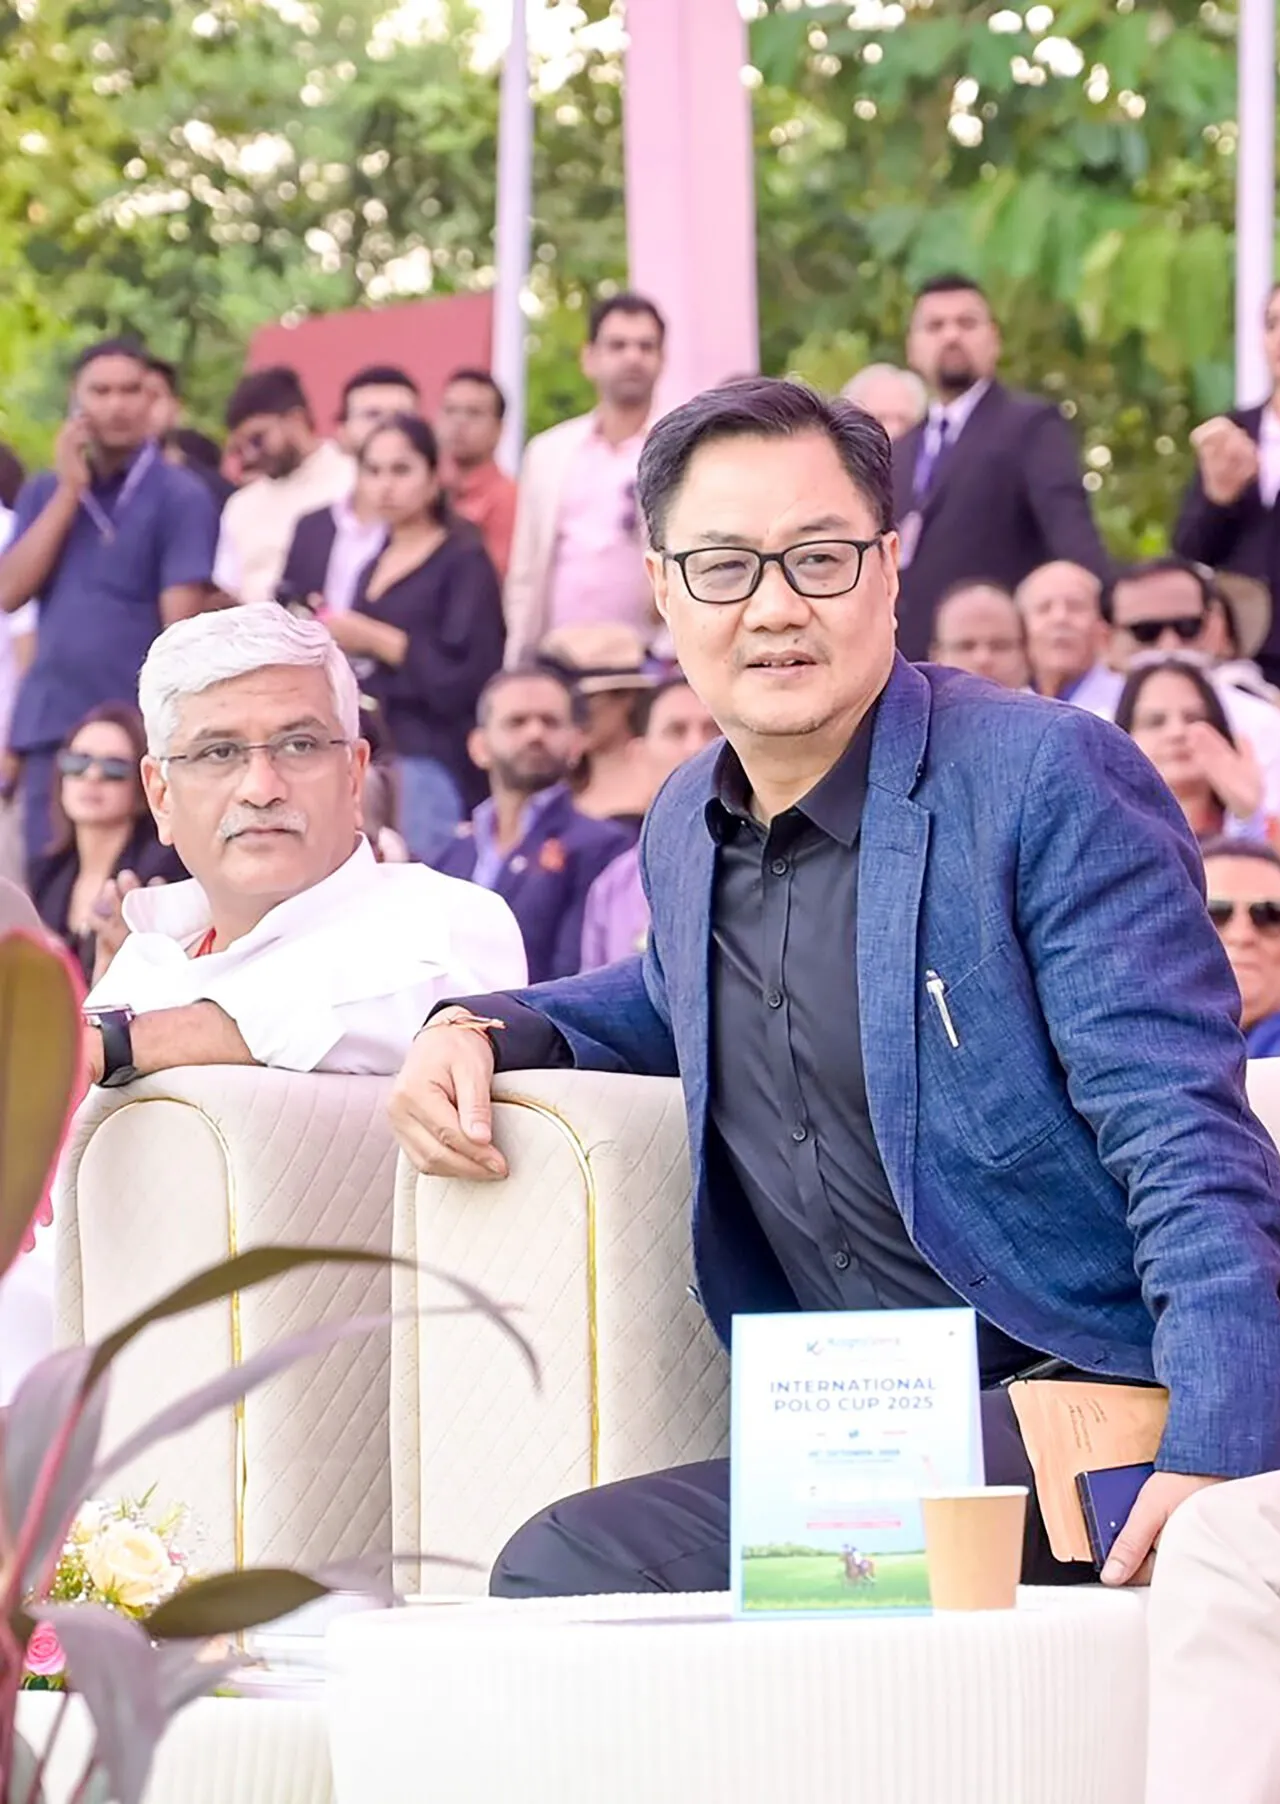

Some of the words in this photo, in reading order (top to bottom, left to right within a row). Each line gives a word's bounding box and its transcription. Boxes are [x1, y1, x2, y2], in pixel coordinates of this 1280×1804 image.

[769, 1376, 937, 1394] INTERNATIONAL
[774, 1398, 831, 1413] POLO
[837, 1396, 880, 1412] CUP
[887, 1395, 934, 1411] 2025
